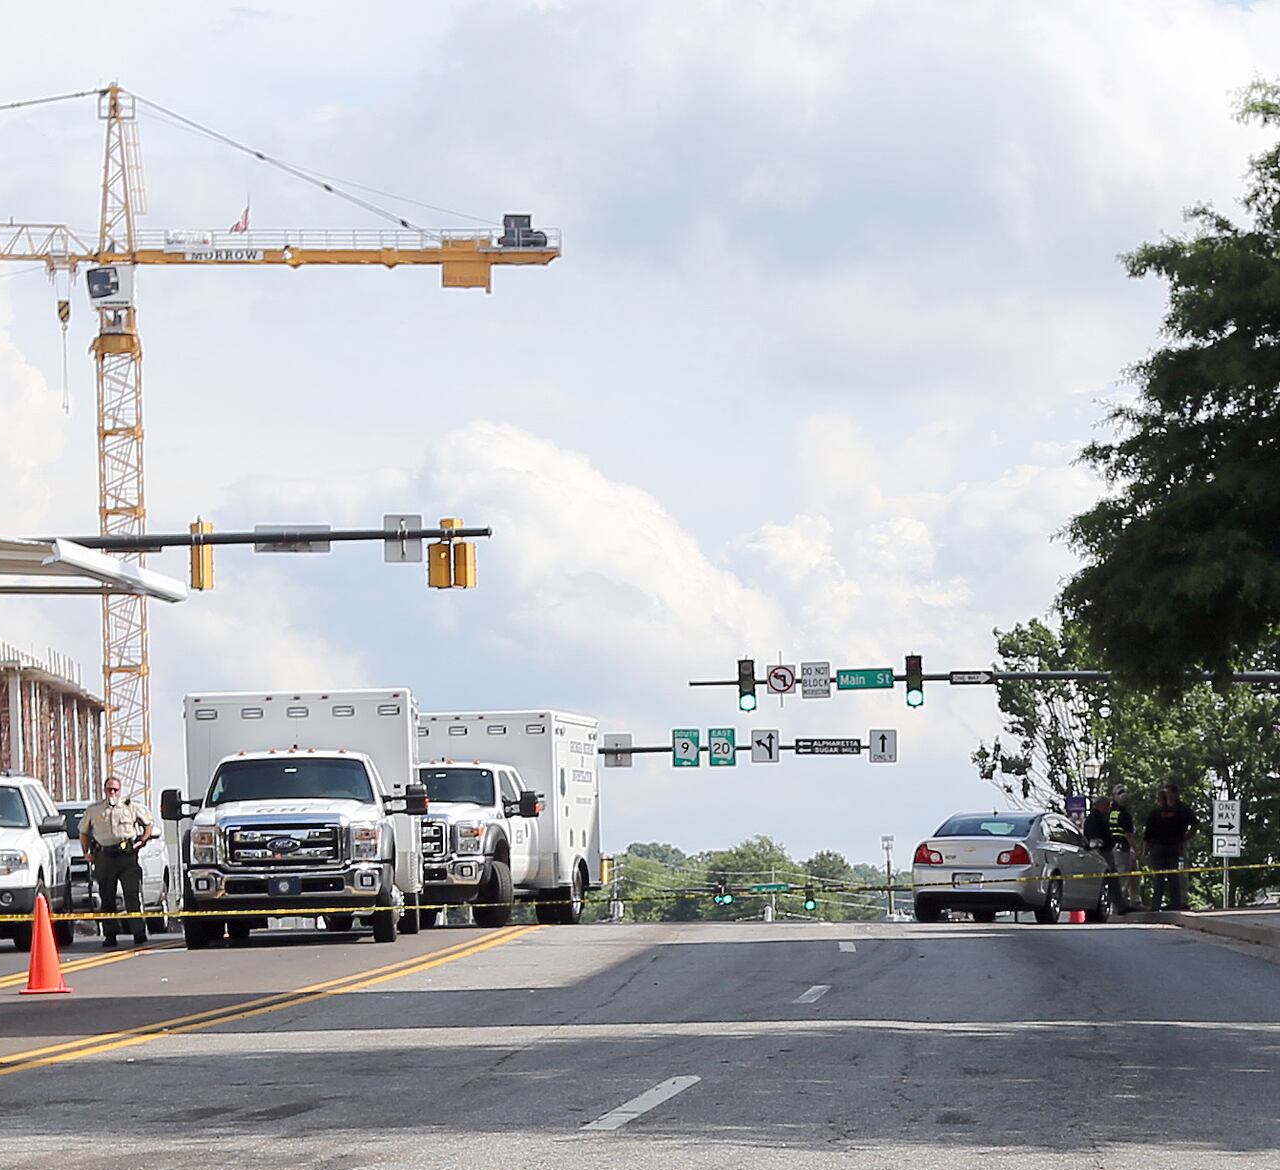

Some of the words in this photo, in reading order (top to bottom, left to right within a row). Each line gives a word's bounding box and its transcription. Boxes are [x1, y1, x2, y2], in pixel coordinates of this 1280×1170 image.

[803, 667, 812, 675] DO
[815, 666, 829, 675] NOT
[803, 680, 829, 688] BLOCK
[840, 675, 866, 686] Main
[877, 673, 890, 684] St
[681, 742, 689, 754] 9
[713, 742, 730, 755] 20
[1218, 803, 1236, 811] ONE
